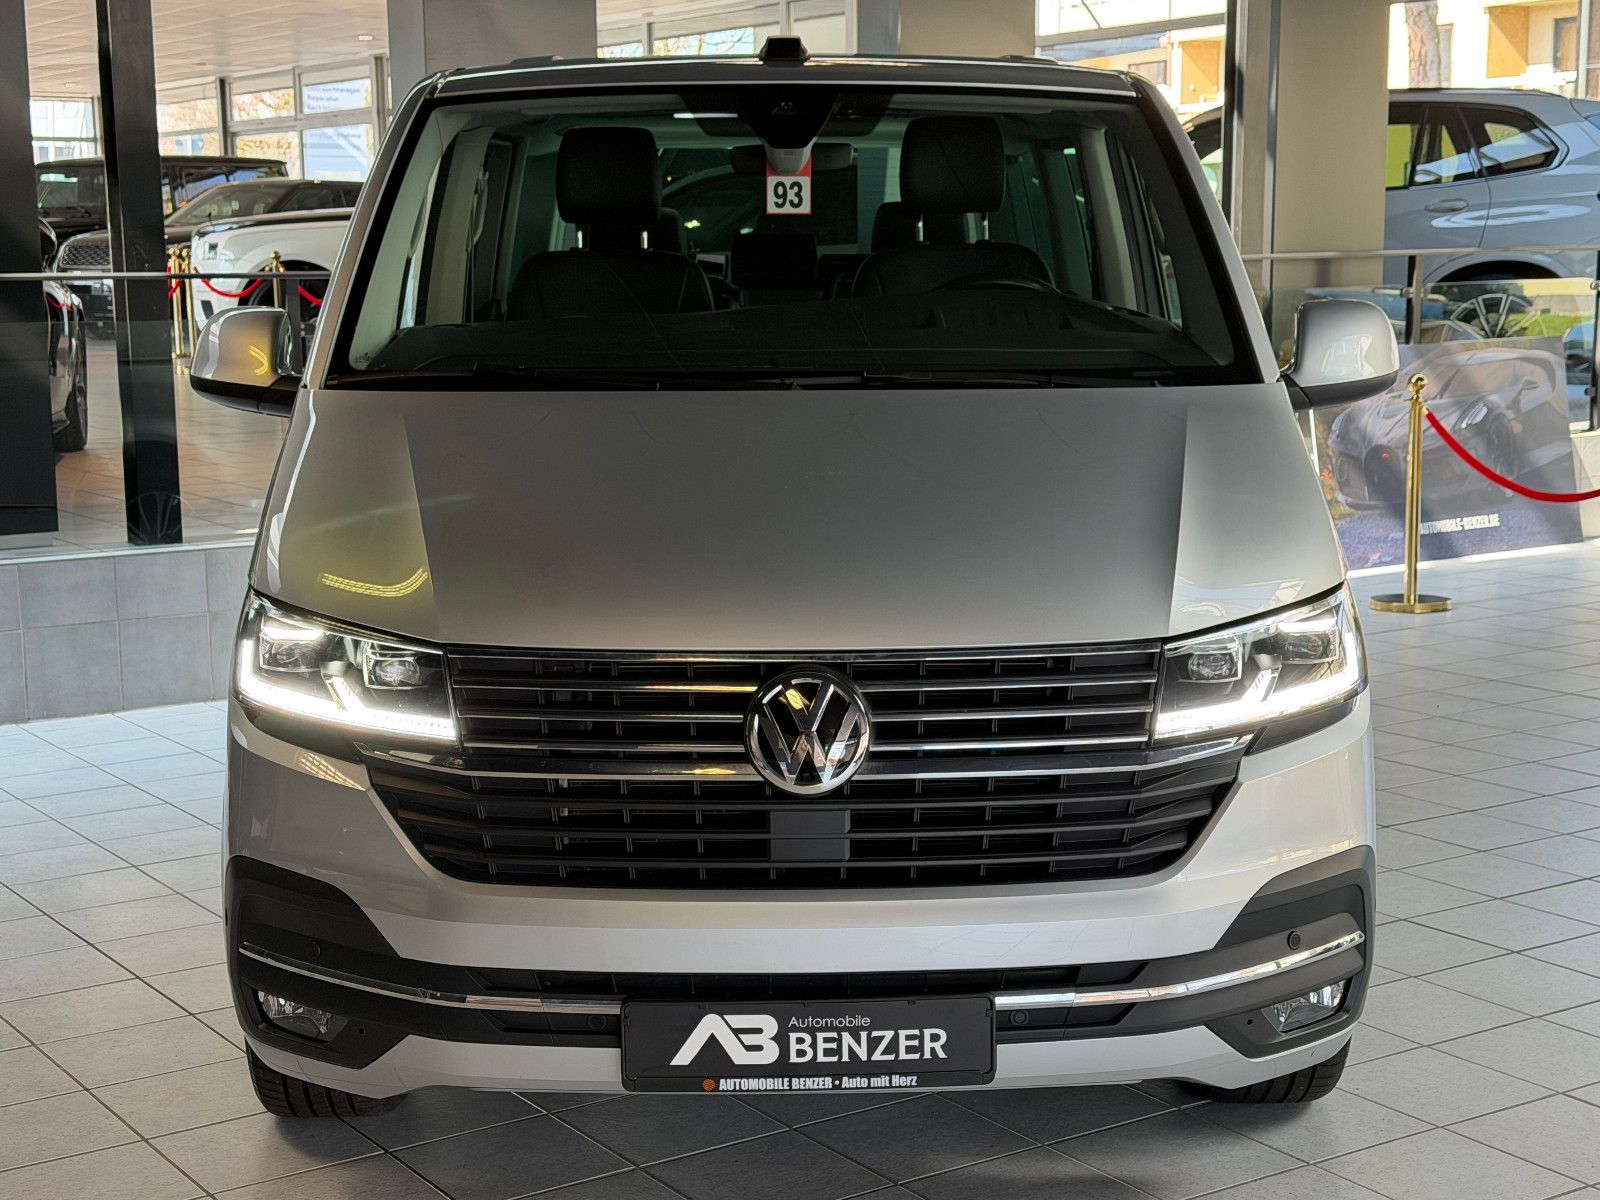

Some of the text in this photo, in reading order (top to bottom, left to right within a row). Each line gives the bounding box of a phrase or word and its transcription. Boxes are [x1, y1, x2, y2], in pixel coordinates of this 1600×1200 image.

[773, 180, 804, 209] 93
[751, 674, 865, 792] VW
[788, 1014, 871, 1028] Automobile
[669, 1013, 780, 1066] AB
[788, 1028, 948, 1063] BENZER
[719, 1074, 918, 1091] AUTOMOBILE BENZER Auto mit Herz
